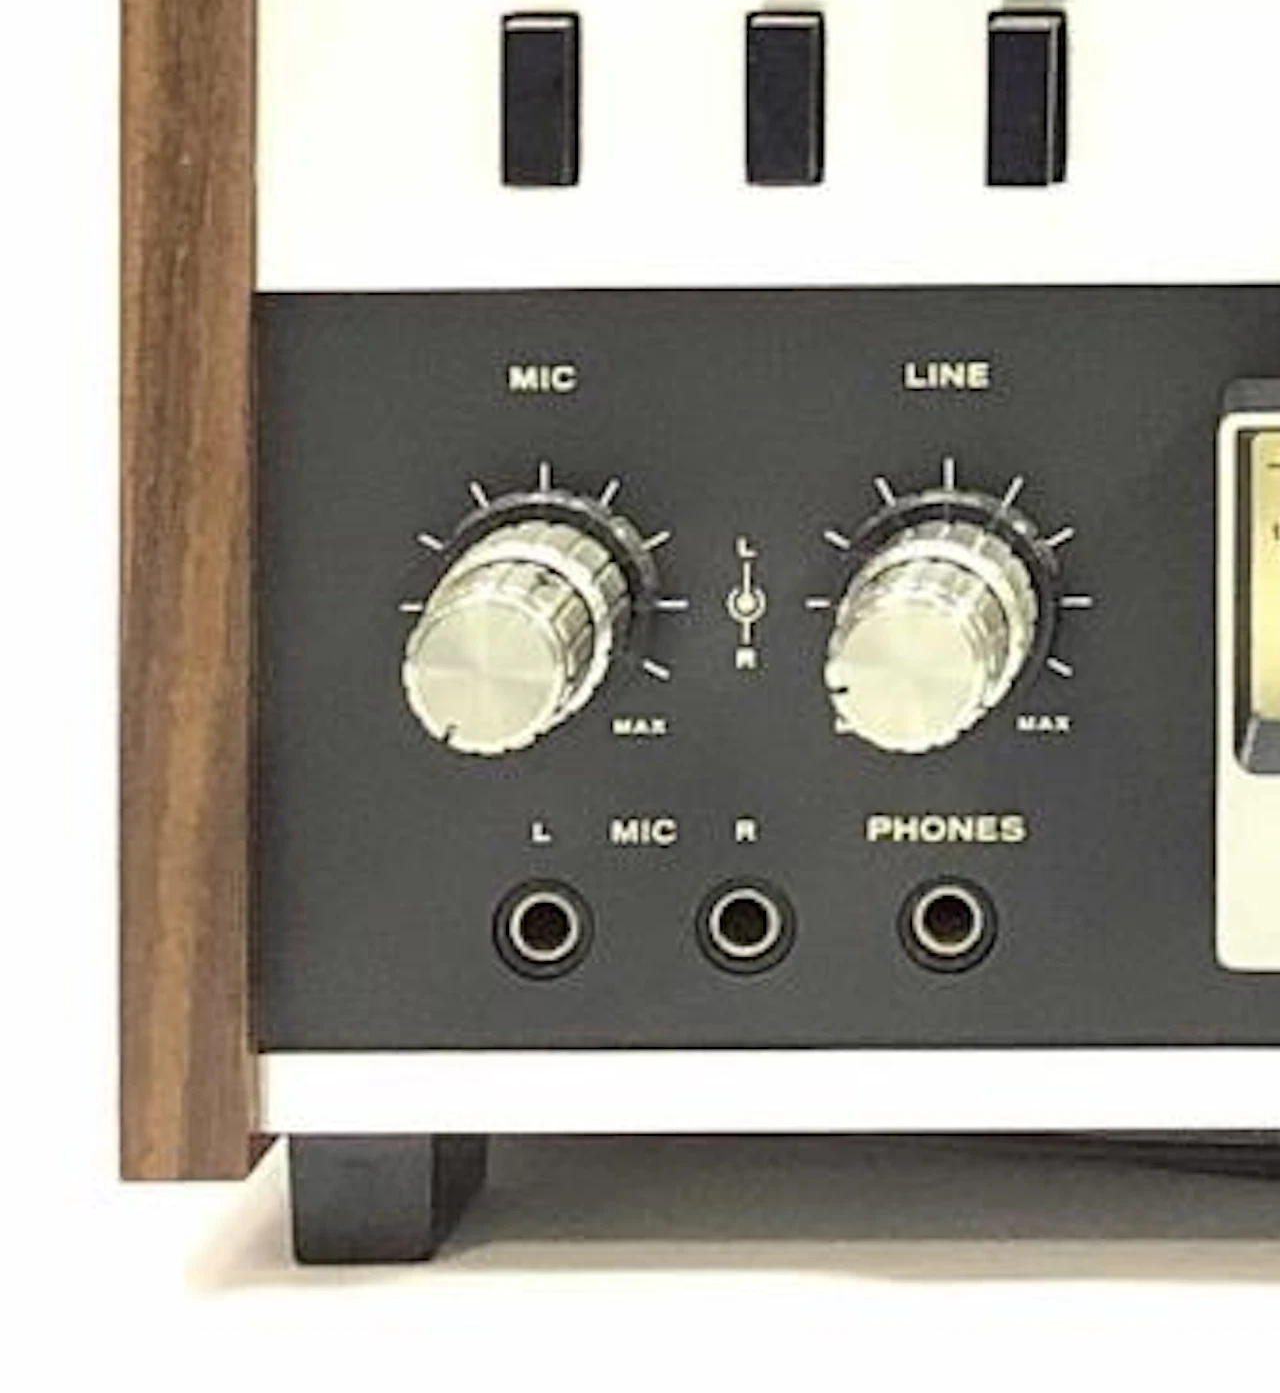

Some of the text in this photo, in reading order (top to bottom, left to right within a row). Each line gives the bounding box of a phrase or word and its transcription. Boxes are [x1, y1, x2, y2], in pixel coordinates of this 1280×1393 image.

[507, 365, 576, 392] MIC
[905, 362, 990, 389] LINE
[737, 538, 756, 559] L
[735, 647, 757, 670] R
[612, 718, 668, 736] MAX
[1016, 715, 1071, 732] MAX
[533, 816, 756, 845] L MIC R
[866, 815, 1026, 843] PHONES
